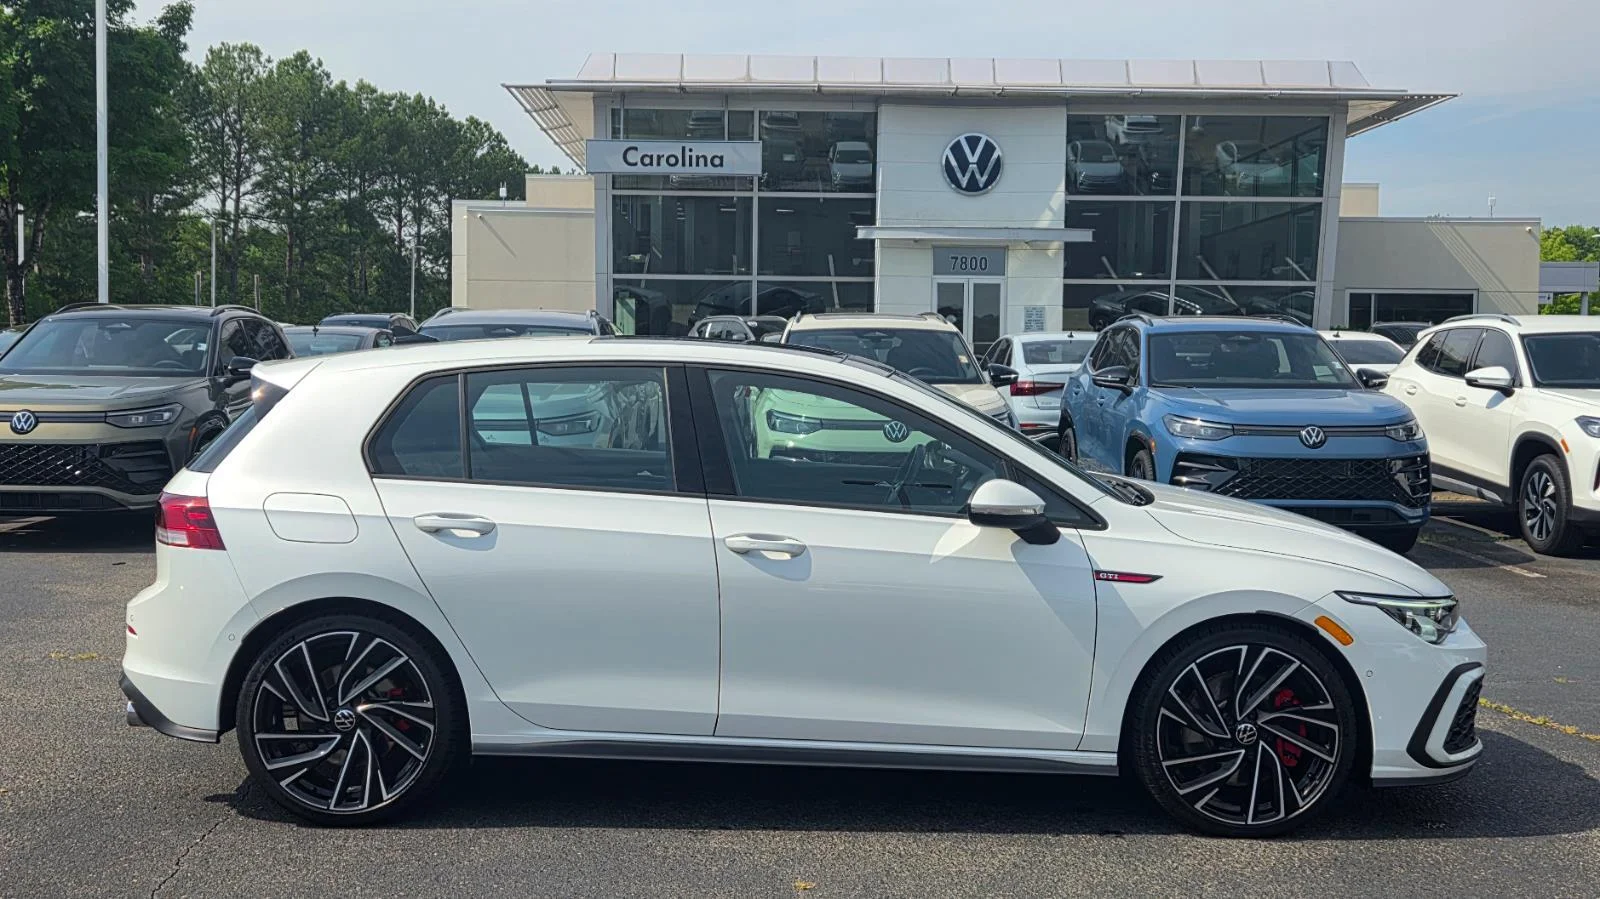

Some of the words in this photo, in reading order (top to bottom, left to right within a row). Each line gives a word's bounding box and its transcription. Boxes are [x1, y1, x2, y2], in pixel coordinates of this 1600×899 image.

[622, 145, 725, 168] Carolina
[943, 133, 1002, 190] VW
[950, 256, 988, 271] 7800
[13, 412, 34, 431] VW
[1099, 572, 1119, 580] GTI
